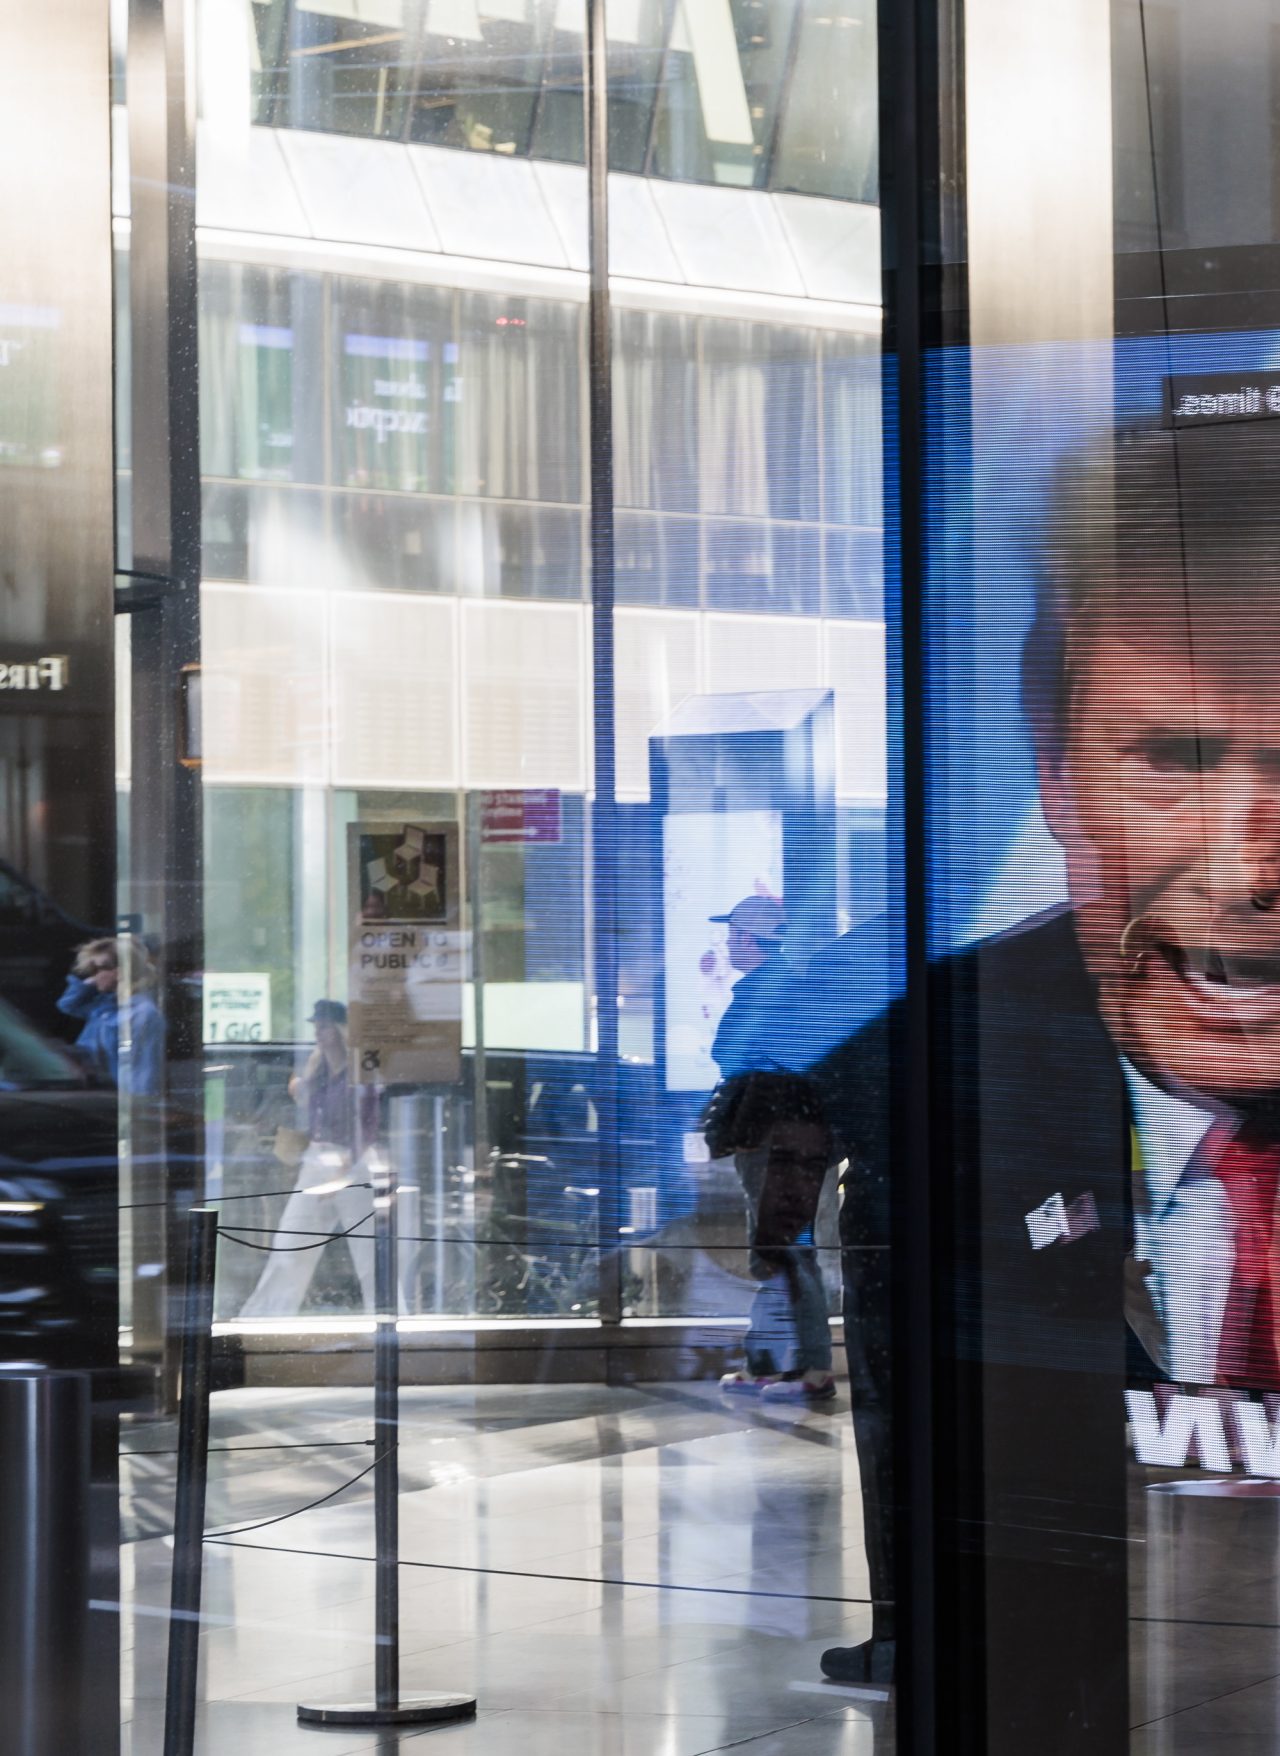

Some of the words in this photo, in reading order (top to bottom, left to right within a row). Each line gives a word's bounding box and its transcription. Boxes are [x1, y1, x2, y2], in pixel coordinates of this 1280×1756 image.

[361, 932, 416, 948] OPEN
[422, 932, 448, 947] TO
[361, 953, 432, 969] PUBLIC
[210, 1022, 218, 1041] 1
[225, 1022, 263, 1042] GIG
